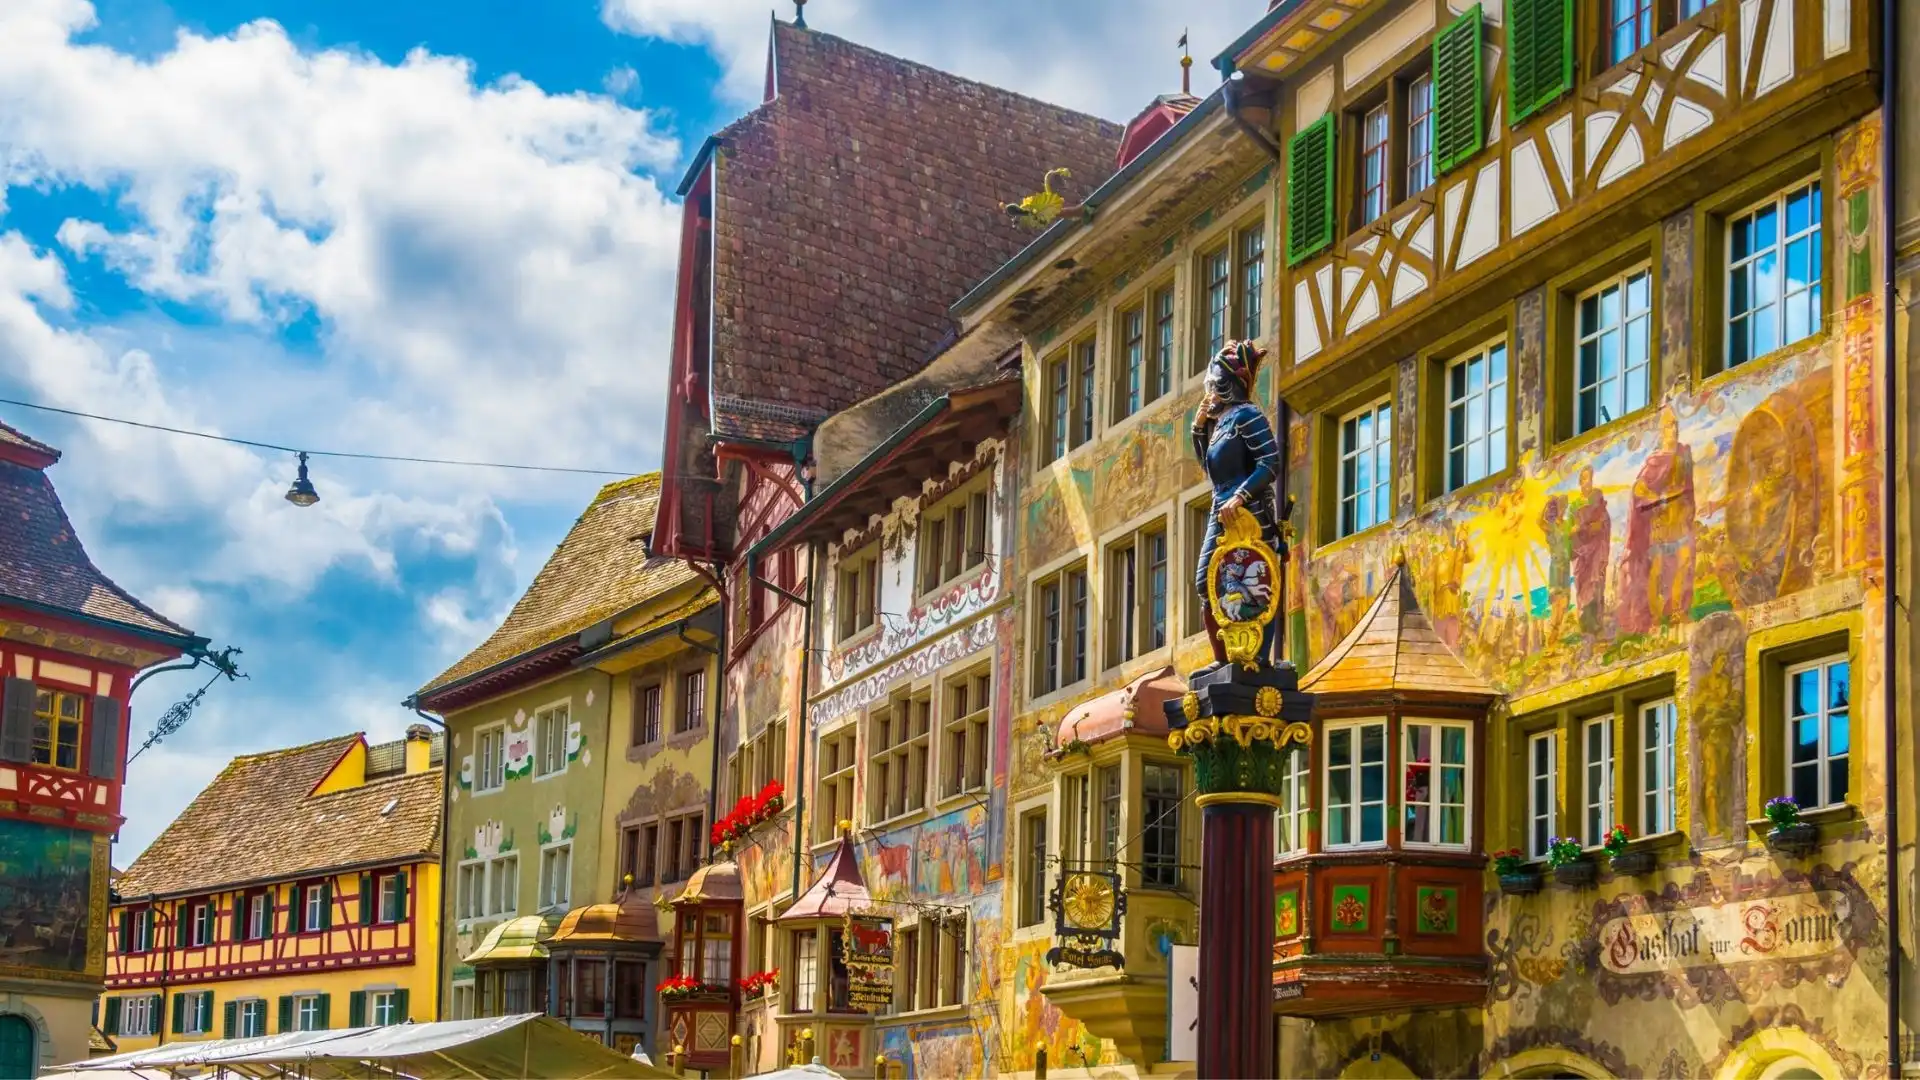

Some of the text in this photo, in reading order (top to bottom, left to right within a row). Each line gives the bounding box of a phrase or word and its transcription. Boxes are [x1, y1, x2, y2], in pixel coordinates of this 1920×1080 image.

[1610, 905, 1840, 968] Gasthof zur Sonne
[850, 992, 890, 1004] Weinstube
